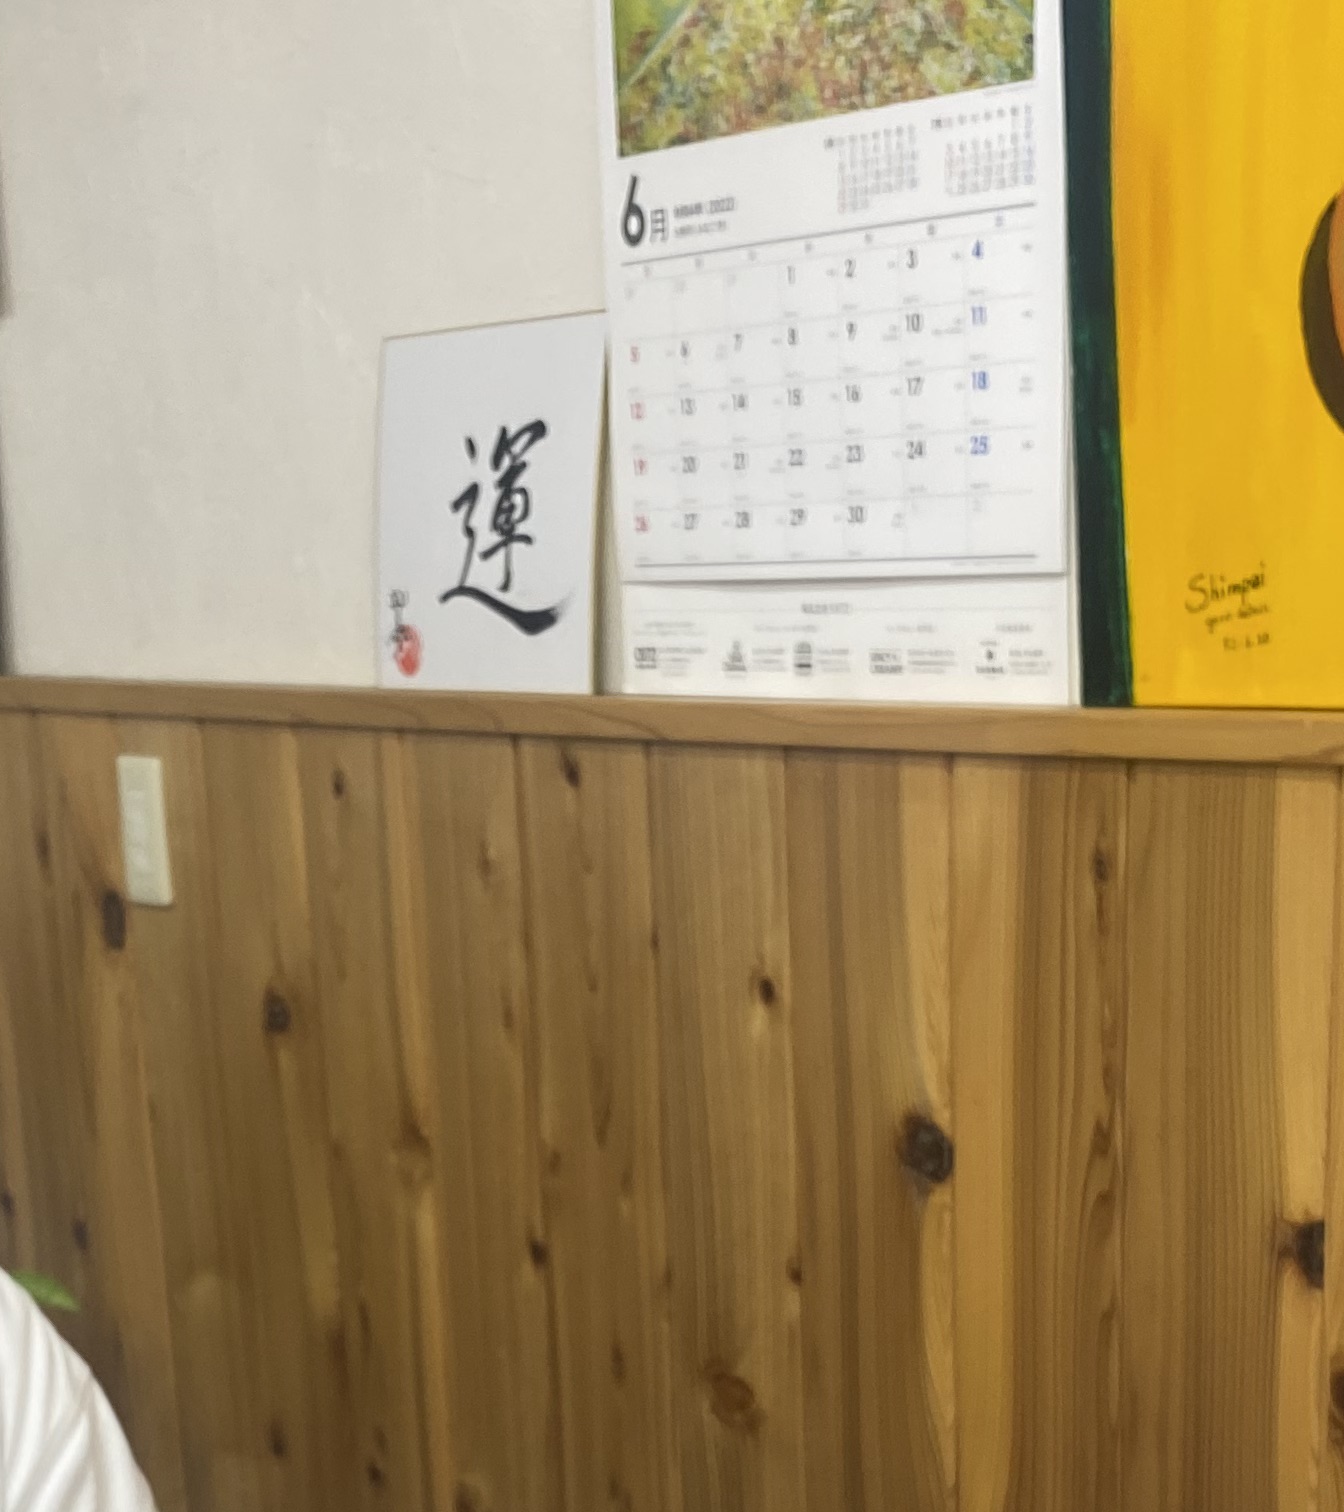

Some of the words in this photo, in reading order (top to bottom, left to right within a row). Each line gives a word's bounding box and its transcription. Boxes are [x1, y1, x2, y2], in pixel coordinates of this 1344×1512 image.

[787, 266, 795, 283] 1
[845, 259, 856, 277] 2
[907, 250, 917, 269] 3
[972, 240, 983, 259] 4
[734, 334, 743, 351] 7
[905, 313, 923, 332] 10
[971, 306, 987, 325] 11
[630, 403, 646, 420] 12
[680, 398, 695, 415] 13
[787, 389, 802, 406] 15
[845, 386, 862, 402] 16
[907, 377, 923, 395] 17
[971, 371, 989, 390] 18
[633, 459, 647, 475] 19
[682, 456, 697, 473] 20
[734, 452, 748, 470] 21
[788, 448, 805, 466] 22
[846, 445, 864, 462] 23
[906, 440, 925, 458] 24
[970, 435, 989, 455] 25
[438, 419, 568, 635] 運
[634, 516, 648, 532] 26
[684, 514, 698, 530] 27
[734, 511, 751, 529] 28
[789, 508, 807, 525] 29
[847, 506, 865, 524] 30
